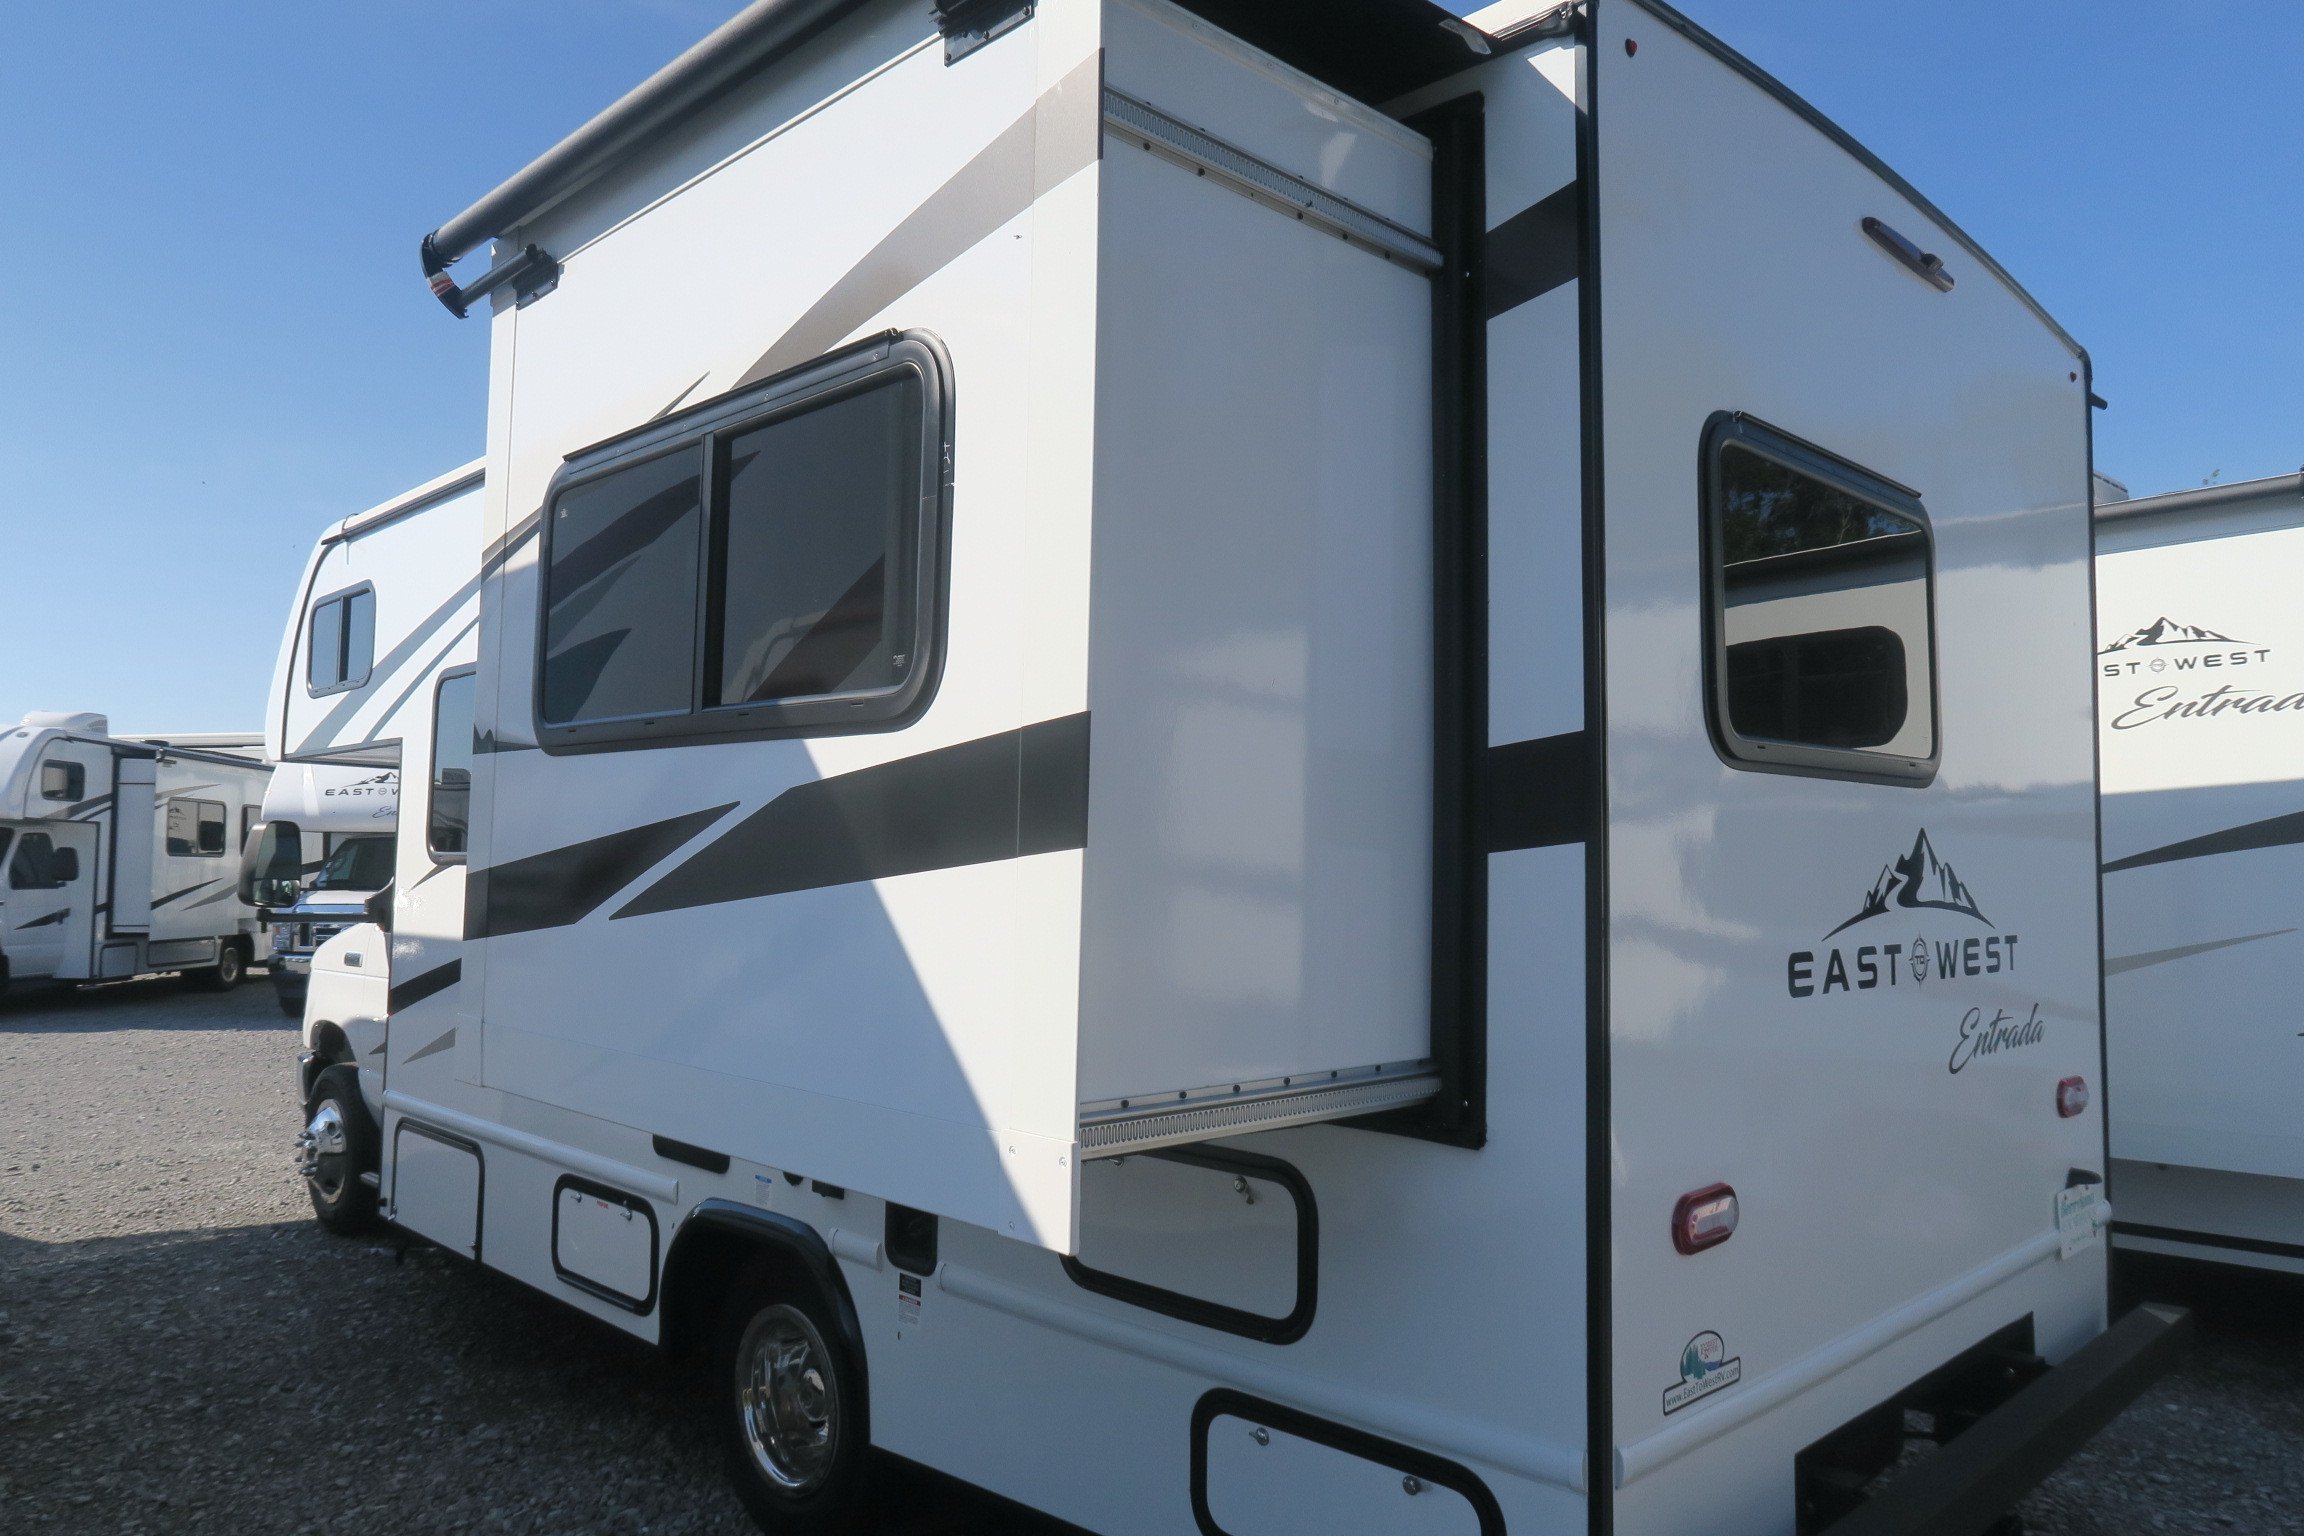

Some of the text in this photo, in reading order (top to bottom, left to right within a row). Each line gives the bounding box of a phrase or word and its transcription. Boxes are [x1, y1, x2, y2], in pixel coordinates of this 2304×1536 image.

[2103, 649, 2271, 677] ST WEST
[325, 788, 375, 797] EAST
[1788, 943, 1902, 999] EAST
[1935, 934, 2018, 980] WEST
[1948, 1003, 2045, 1075] Entrada
